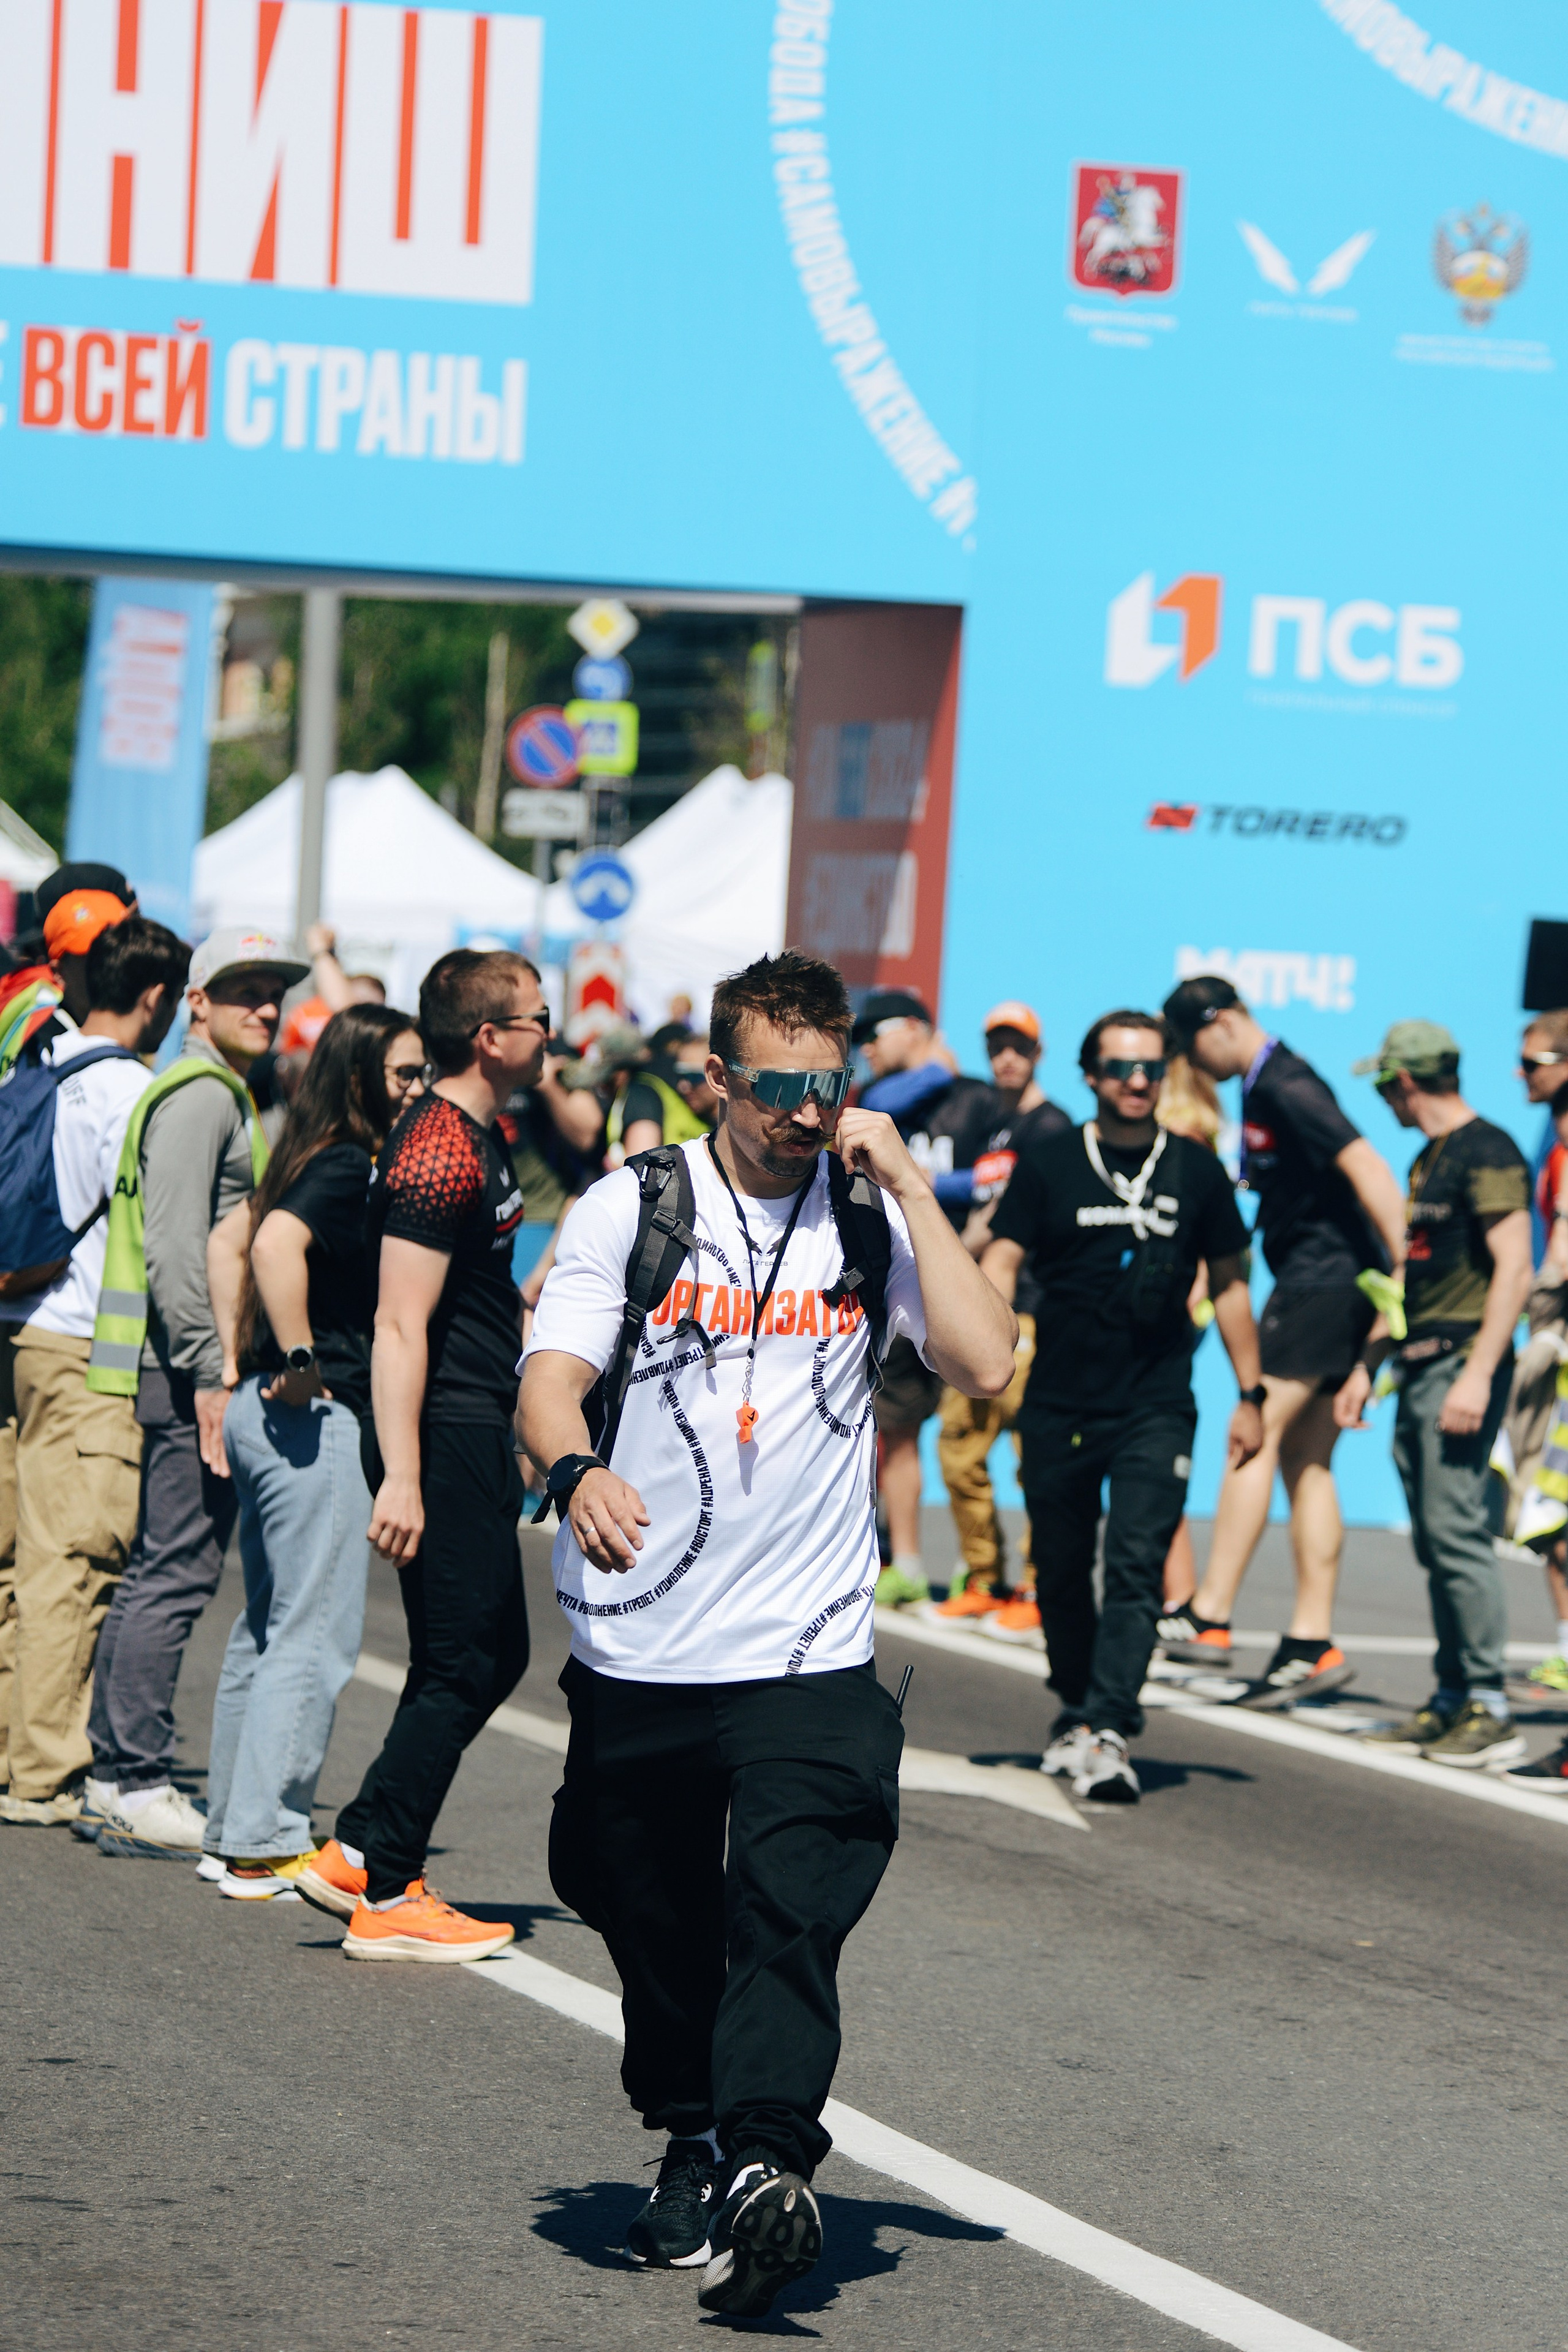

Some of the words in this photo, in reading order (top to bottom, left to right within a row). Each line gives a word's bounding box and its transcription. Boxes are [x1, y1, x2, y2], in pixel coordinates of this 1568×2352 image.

[1318, 0, 1568, 161] МОВЫРАЖЕН
[771, 127, 962, 502] #САМОВЫРАЖЕНИЕ
[18, 317, 212, 443] ВСЕЙ
[223, 337, 529, 466] СТРАНЫ
[1248, 594, 1464, 690] ПСБ
[1205, 804, 1408, 847] TORERO
[639, 1321, 657, 1359] #САМО
[628, 1358, 674, 1385] #УДИВЛЕНИ
[662, 1379, 680, 1409] #ЦЕЛЬ
[673, 1408, 701, 1449] #МОМЕНТ
[691, 1447, 714, 1508] #АДРЕНАЛИН
[688, 1509, 713, 1555] #ВОСТОРГ
[653, 1550, 698, 1599] #УДИВЛЕНИЕ
[577, 1600, 623, 1617] #ВОЛНЕНИЕ
[622, 1589, 656, 1615] #ТРЕПЕТ
[797, 1612, 828, 1651] #ТРЕПЕТ
[784, 1648, 807, 1676] #УДИ
